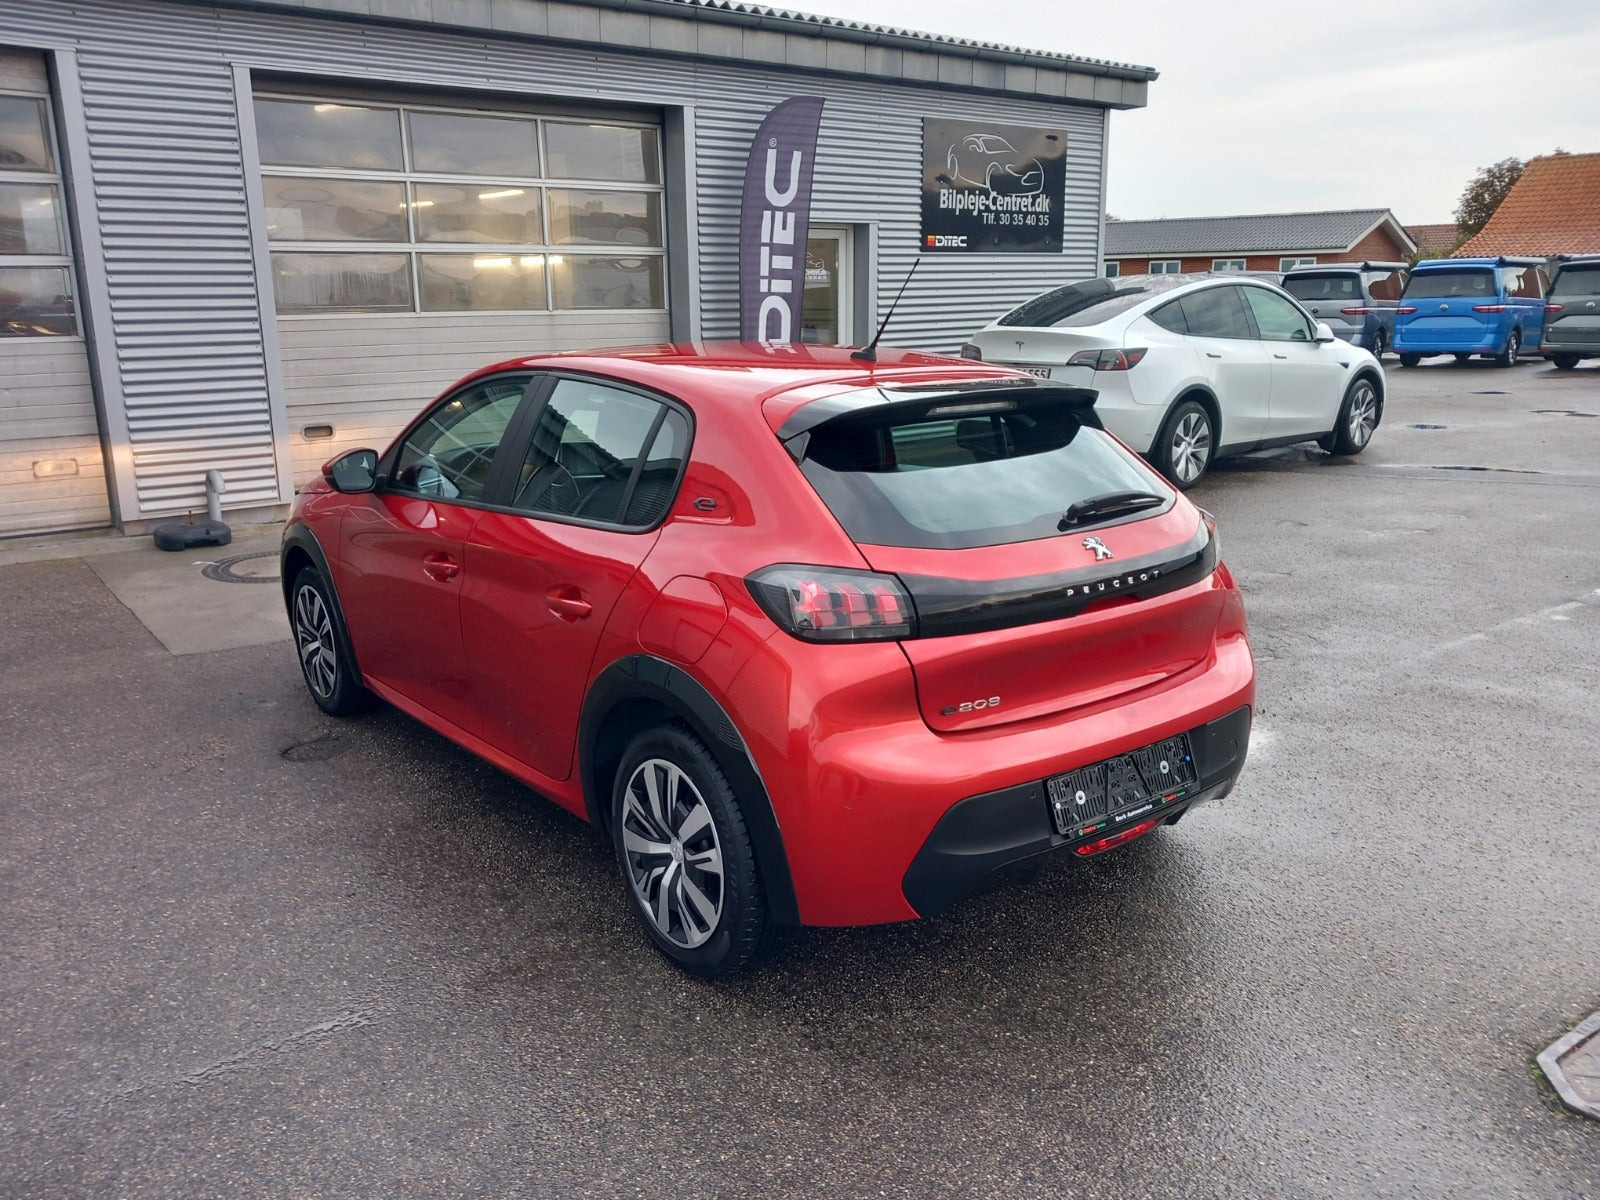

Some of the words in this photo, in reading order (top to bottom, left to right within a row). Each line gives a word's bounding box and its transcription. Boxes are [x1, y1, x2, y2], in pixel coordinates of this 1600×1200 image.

[940, 189, 1050, 215] Bilpleje-Centret.dk
[982, 213, 997, 225] Tlf.
[1000, 214, 1010, 225] 30
[1013, 214, 1023, 225] 35
[1025, 214, 1036, 226] 40
[1039, 215, 1049, 226] 35
[1067, 570, 1161, 597] PEUGEOT
